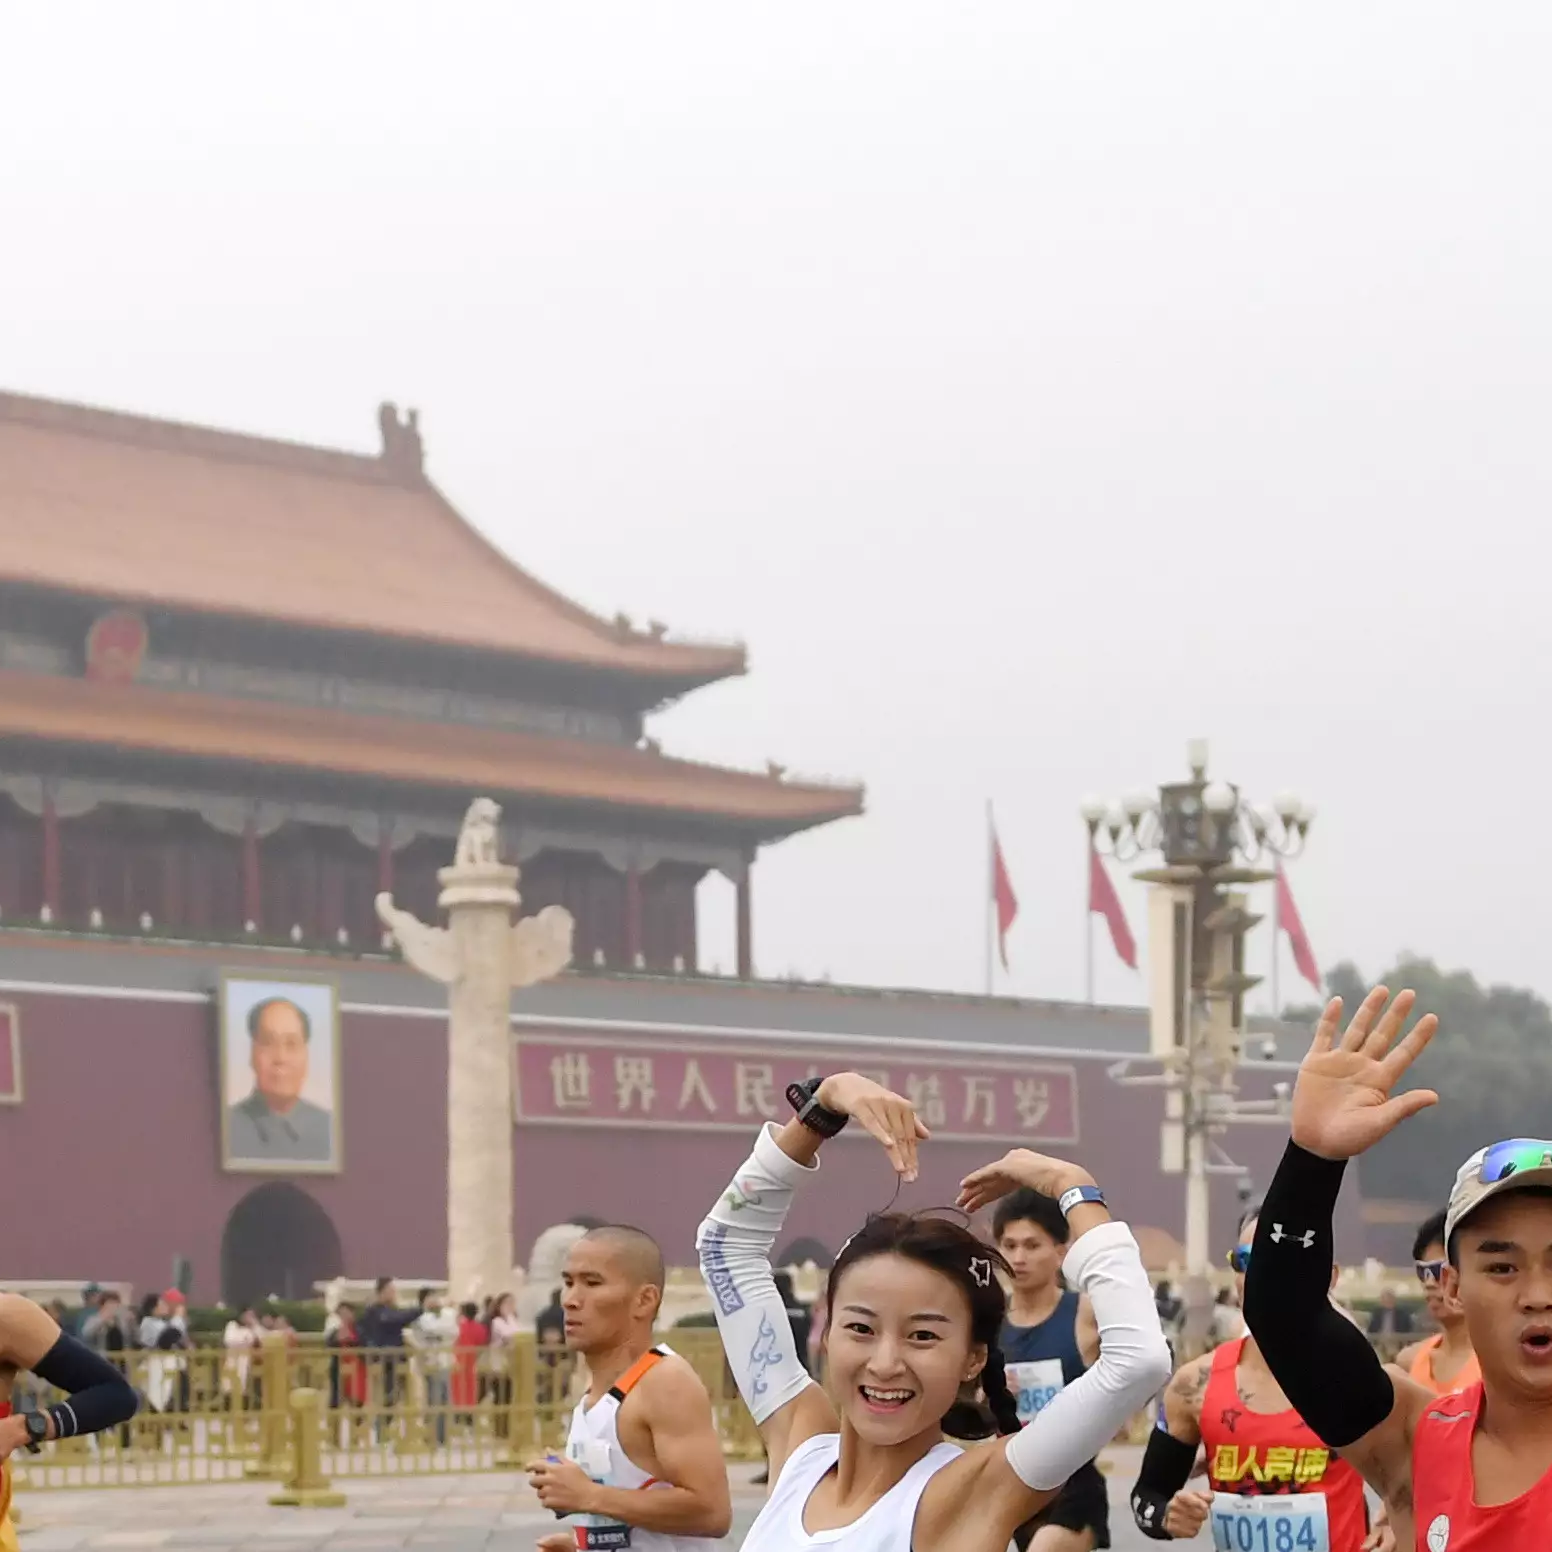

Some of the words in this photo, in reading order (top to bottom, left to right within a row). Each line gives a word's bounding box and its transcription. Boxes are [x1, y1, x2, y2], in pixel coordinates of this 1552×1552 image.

[549, 1053, 1050, 1128] 世界人民结万岁
